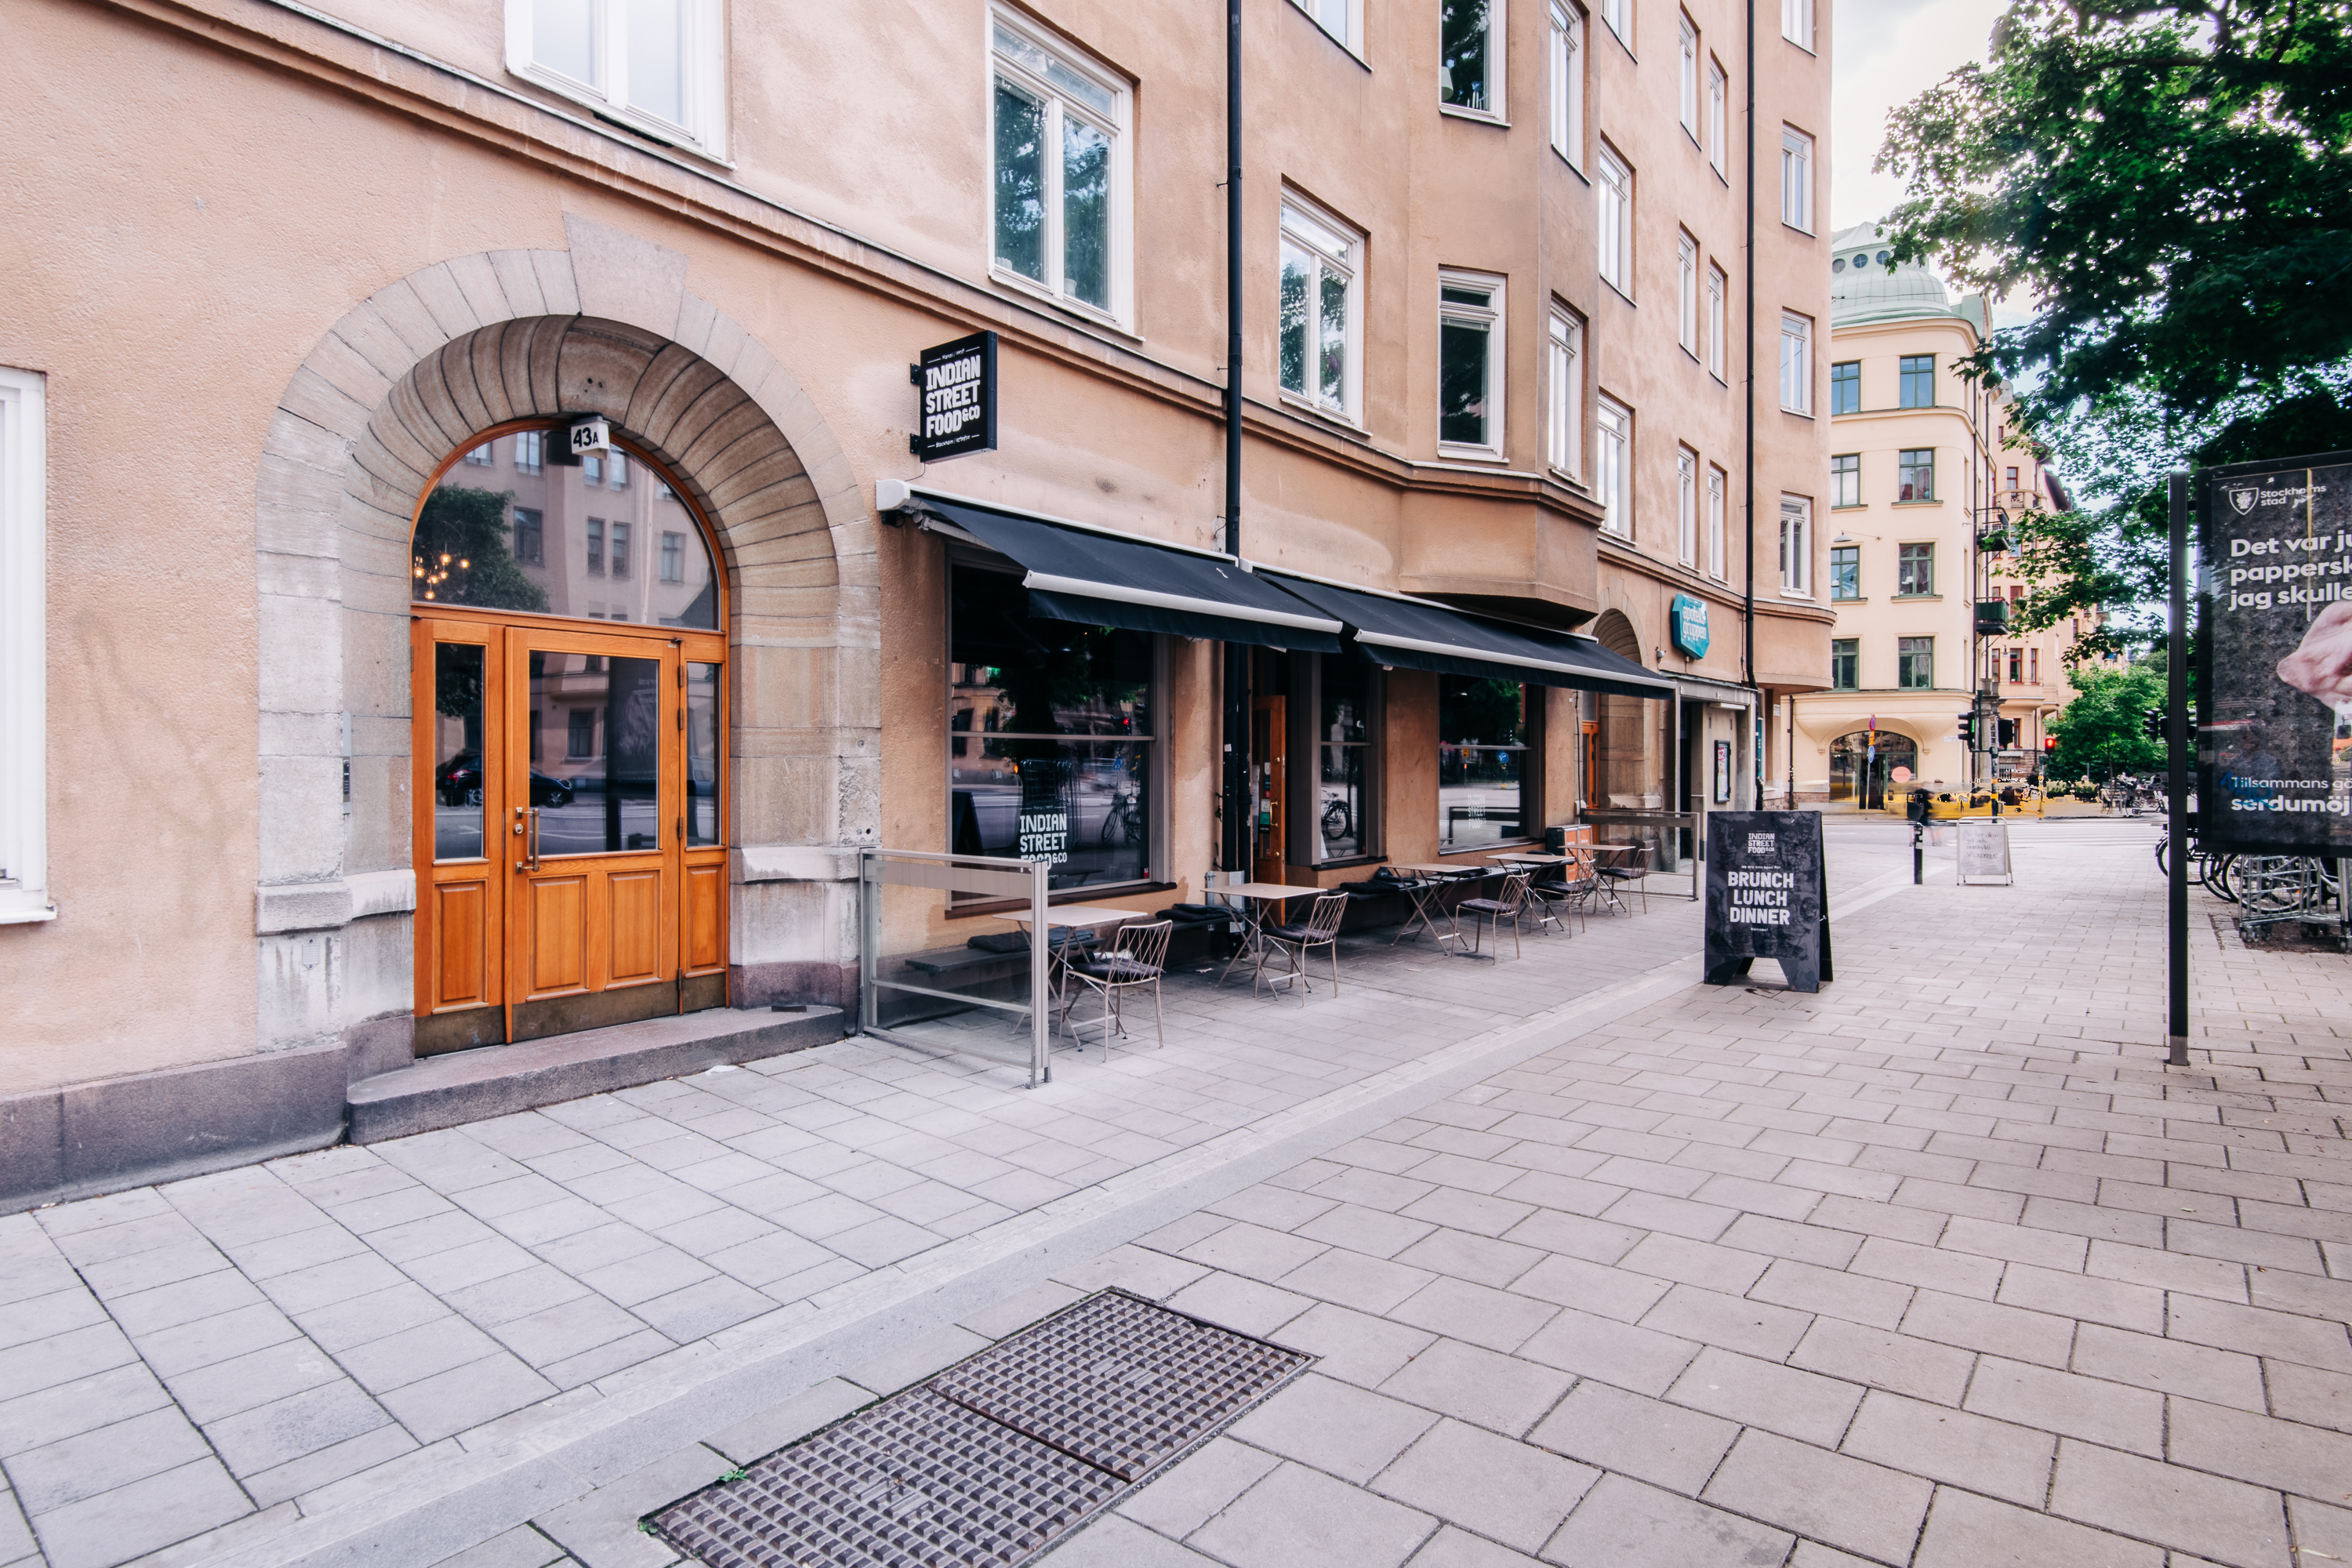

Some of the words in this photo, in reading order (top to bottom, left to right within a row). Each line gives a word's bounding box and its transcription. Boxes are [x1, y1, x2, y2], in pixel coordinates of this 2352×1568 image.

[926, 354, 981, 391] INDIAN
[926, 379, 981, 414] STREET
[2260, 485, 2327, 498] Stockhoms
[2260, 496, 2287, 506] stad
[2230, 538, 2280, 557] Det
[2284, 535, 2332, 551] var
[2228, 590, 2272, 611] jag
[2277, 582, 2352, 604] skulle
[1682, 621, 1707, 641] gruppen
[2230, 795, 2352, 816] serdumöj
[1020, 814, 1067, 833] INDIAN
[1020, 833, 1067, 852] STREET
[1728, 871, 1794, 888] BRUNCH
[1733, 889, 1788, 906] LUNCH
[1730, 907, 1791, 925] DINNER
